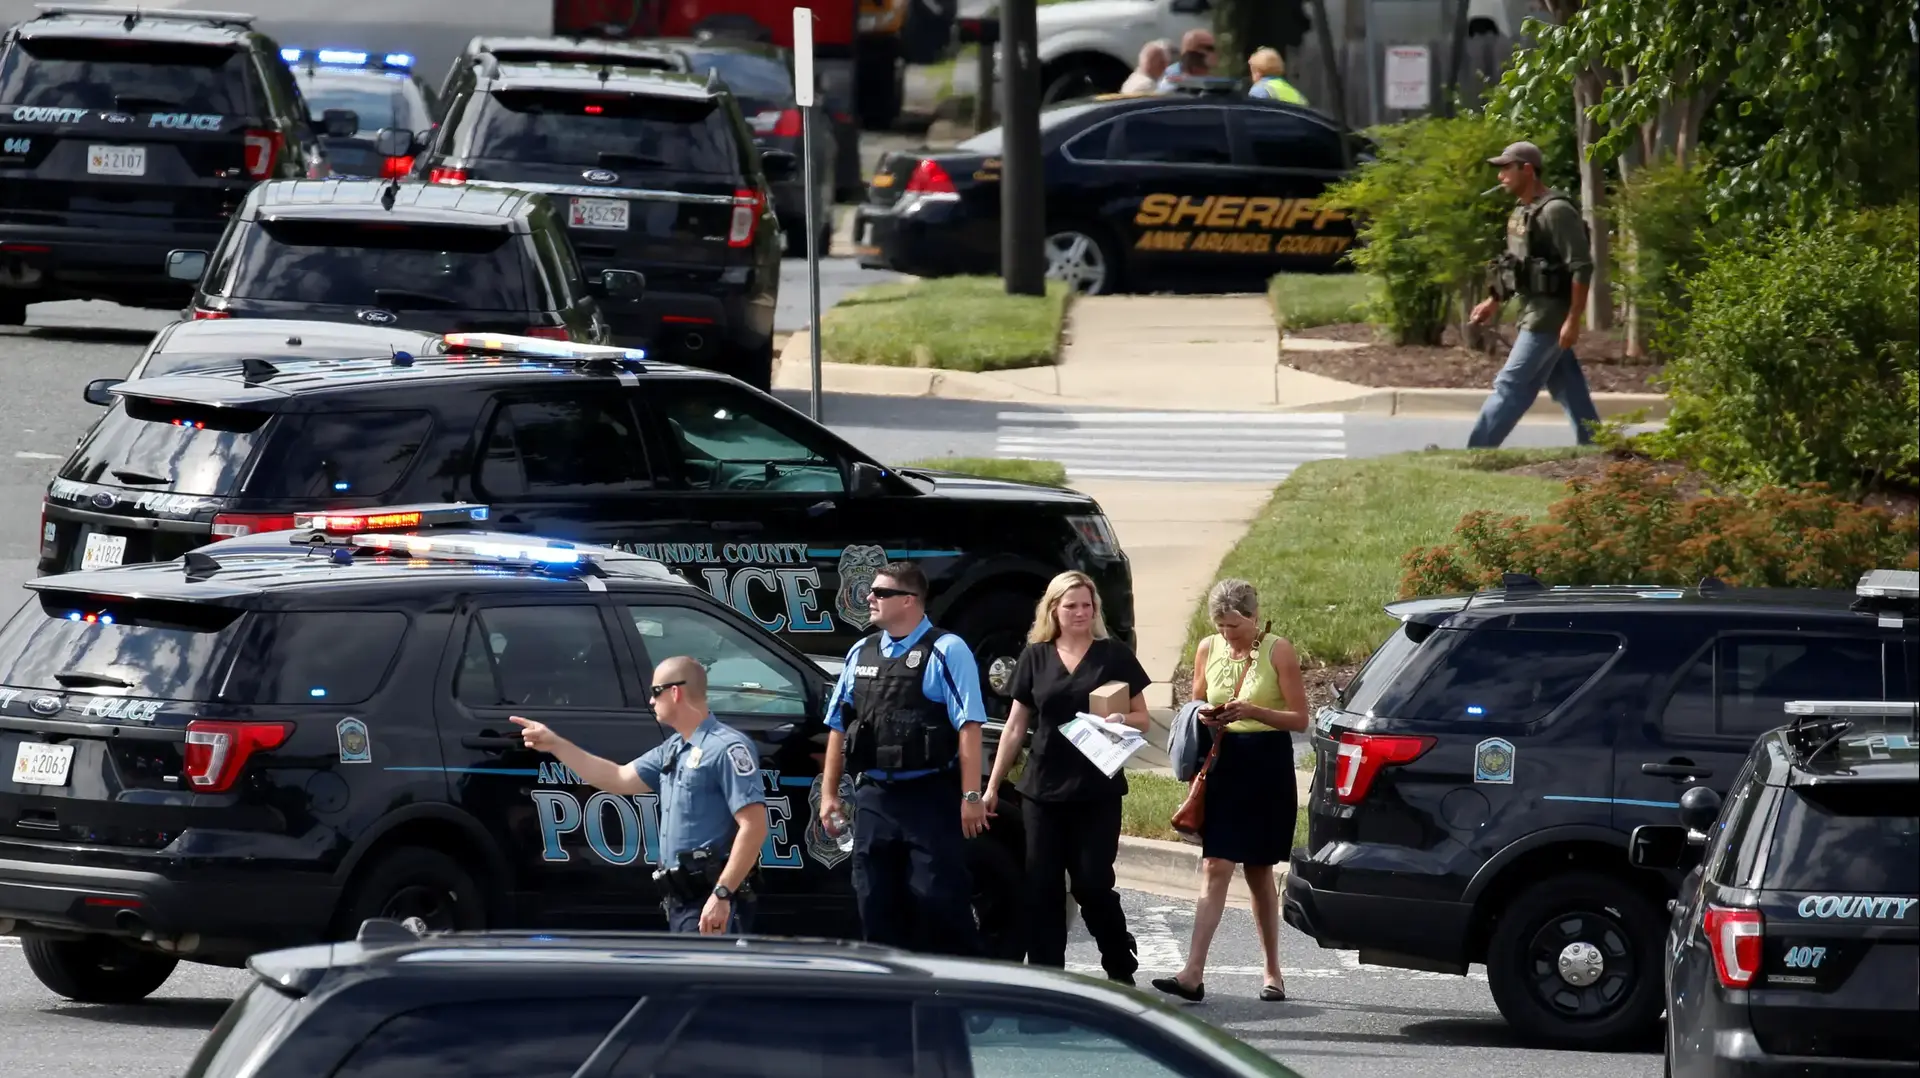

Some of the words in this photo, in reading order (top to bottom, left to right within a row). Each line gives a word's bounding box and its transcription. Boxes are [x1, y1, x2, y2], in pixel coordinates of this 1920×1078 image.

[13, 106, 89, 124] COUNTY
[148, 113, 224, 131] POLICE
[723, 543, 809, 564] COUNTY
[702, 566, 835, 633] ICE
[855, 665, 879, 677] POLICE
[82, 696, 164, 721] POLICE
[538, 761, 588, 785] ANN
[1798, 895, 1918, 919] COUNTY
[1784, 946, 1826, 968] 407
